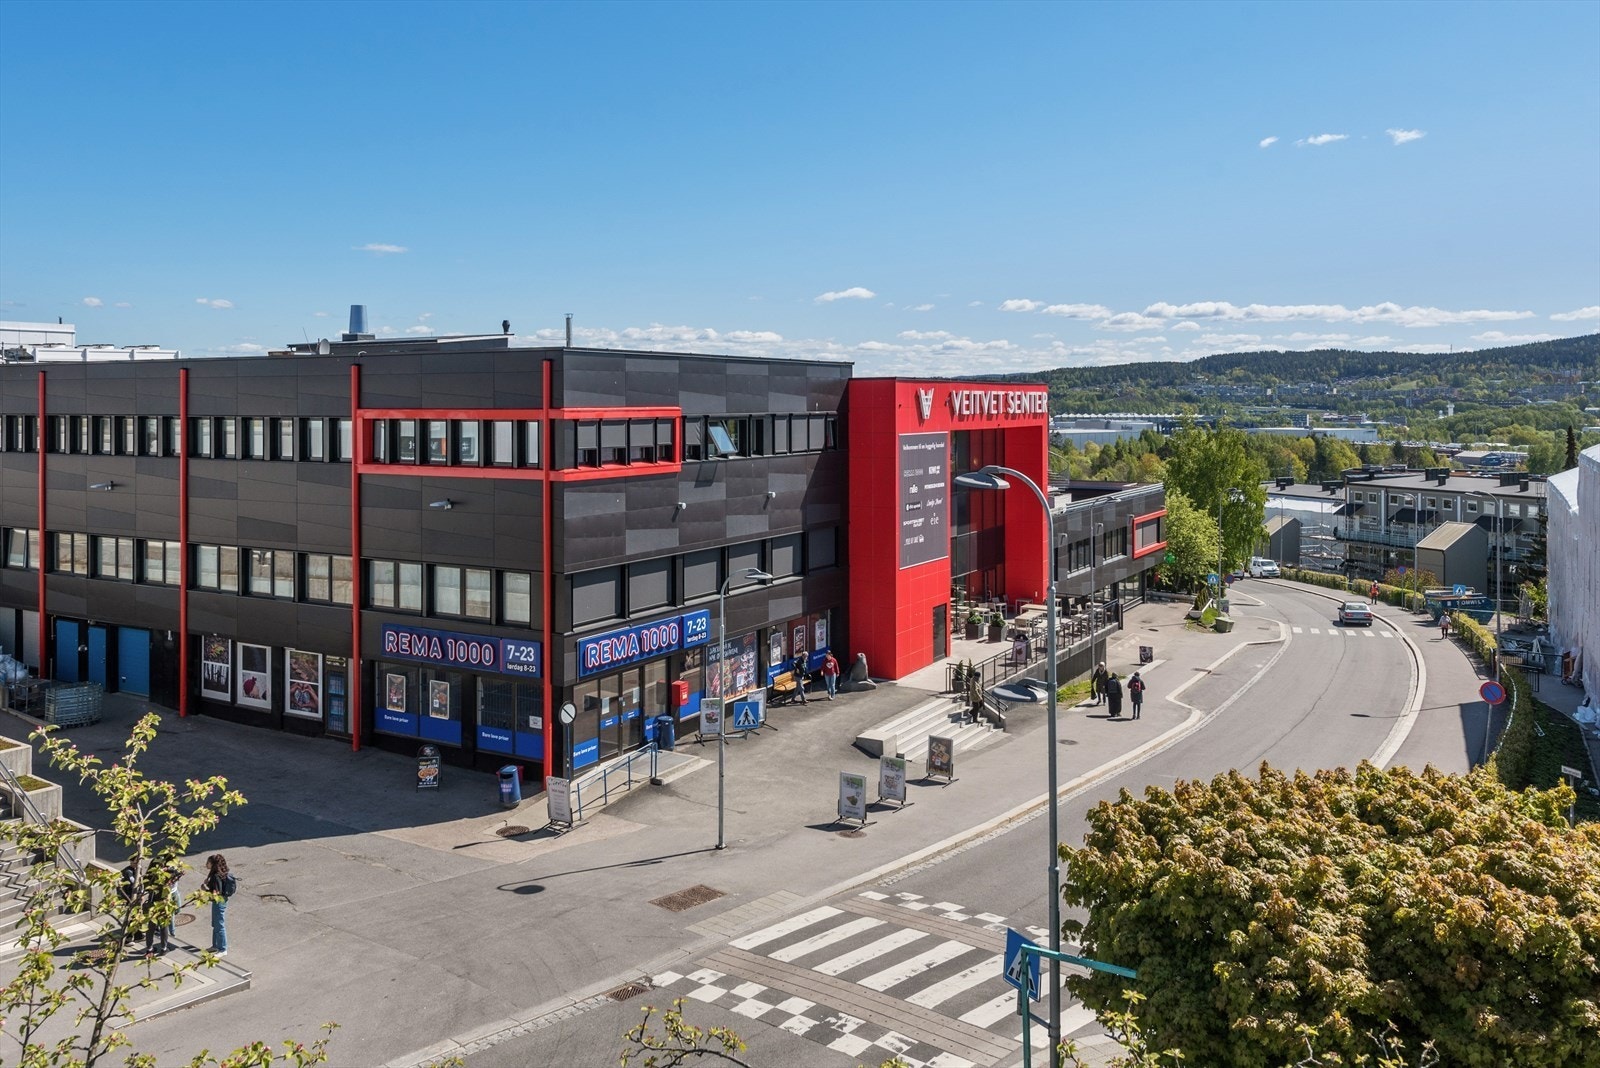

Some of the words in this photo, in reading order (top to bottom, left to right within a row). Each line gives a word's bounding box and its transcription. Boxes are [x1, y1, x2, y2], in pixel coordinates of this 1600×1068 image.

[952, 390, 1005, 415] VEITVET
[1007, 391, 1048, 414] SENTER
[687, 617, 706, 634] 7-23
[386, 631, 442, 659] REMA
[447, 639, 494, 665] 1000
[507, 644, 535, 662] 7-23
[586, 634, 640, 668] REMA
[641, 623, 680, 652] 1000
[524, 665, 536, 673] 8-23
